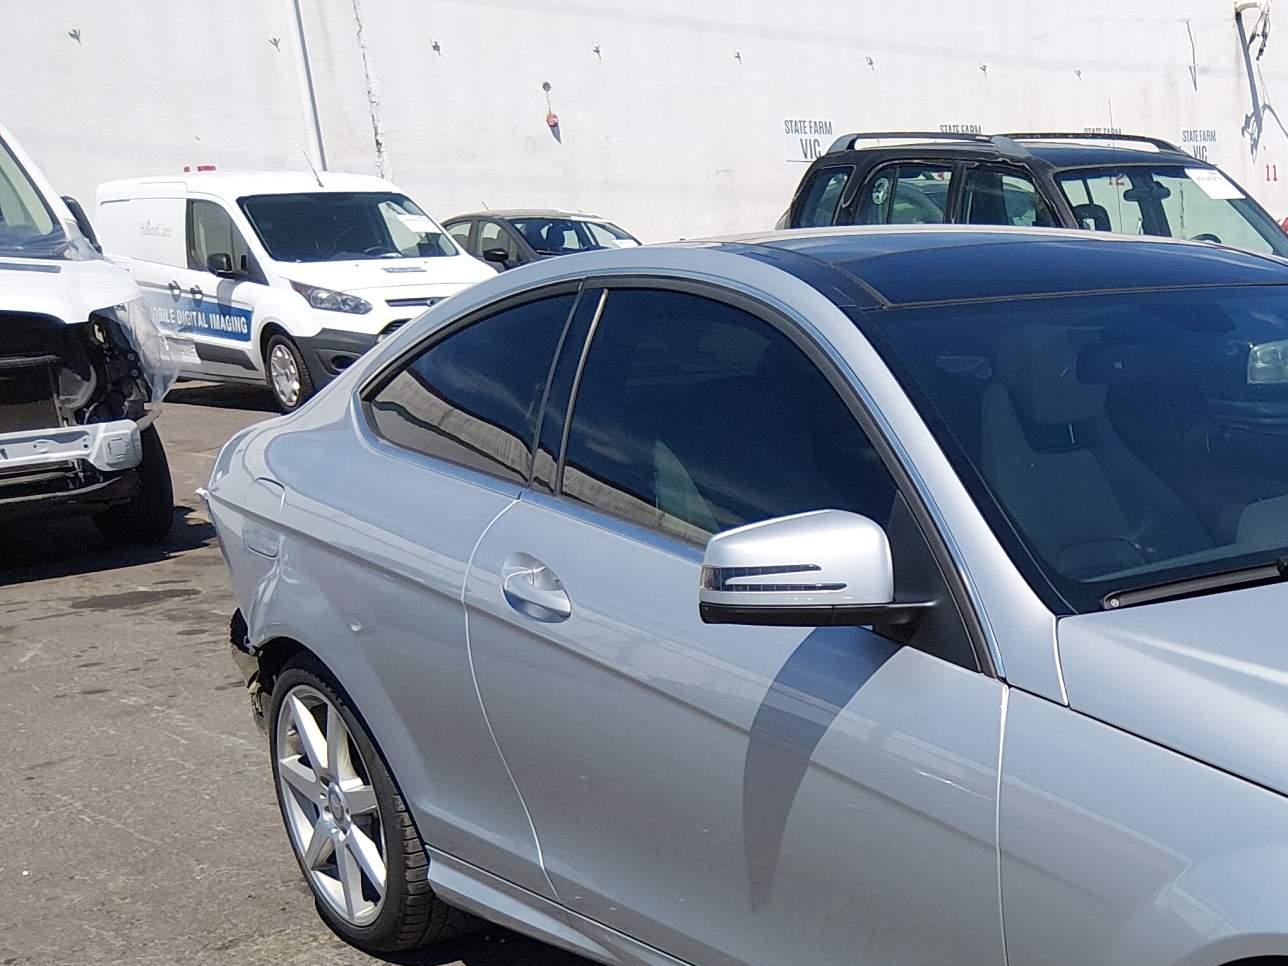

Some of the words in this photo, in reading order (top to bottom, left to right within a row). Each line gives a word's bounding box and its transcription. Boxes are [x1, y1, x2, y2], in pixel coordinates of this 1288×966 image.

[785, 119, 808, 135] STATE
[809, 120, 833, 136] FARM
[1182, 129, 1199, 143] STATE
[1200, 129, 1217, 143] FARM
[1265, 164, 1278, 182] 11
[176, 309, 209, 328] DIGITAL
[209, 313, 249, 335] IMAGING
